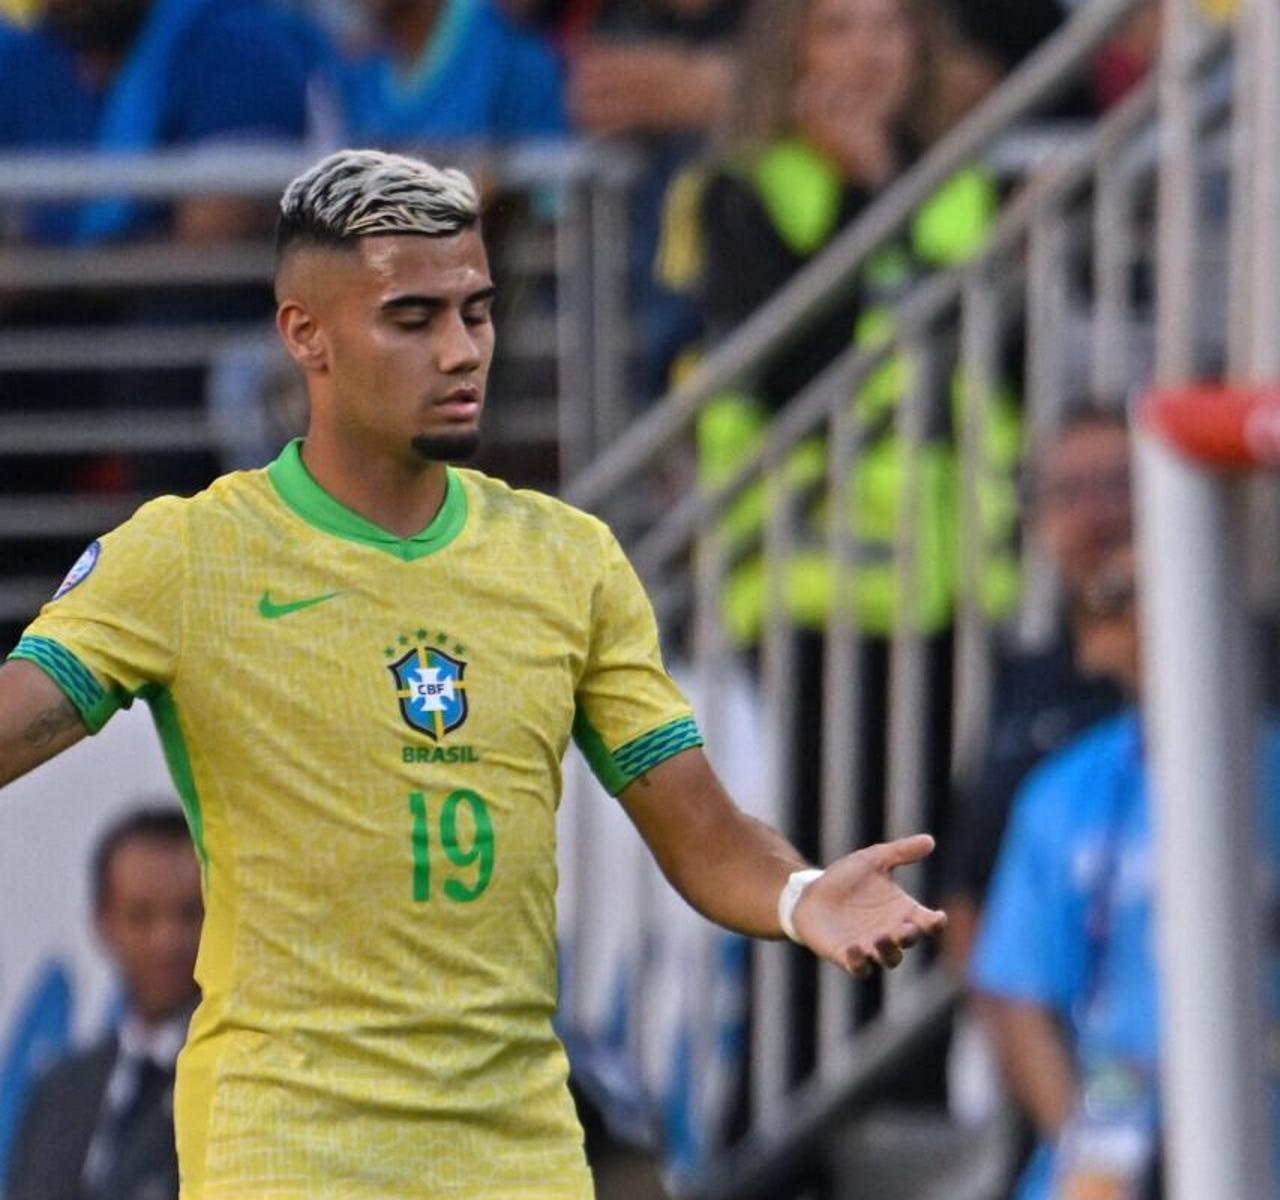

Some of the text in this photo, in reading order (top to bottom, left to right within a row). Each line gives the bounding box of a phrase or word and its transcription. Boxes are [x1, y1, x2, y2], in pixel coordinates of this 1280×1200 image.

[417, 683, 445, 695] CBF
[401, 746, 479, 763] BRASIL
[408, 788, 496, 904] 19
